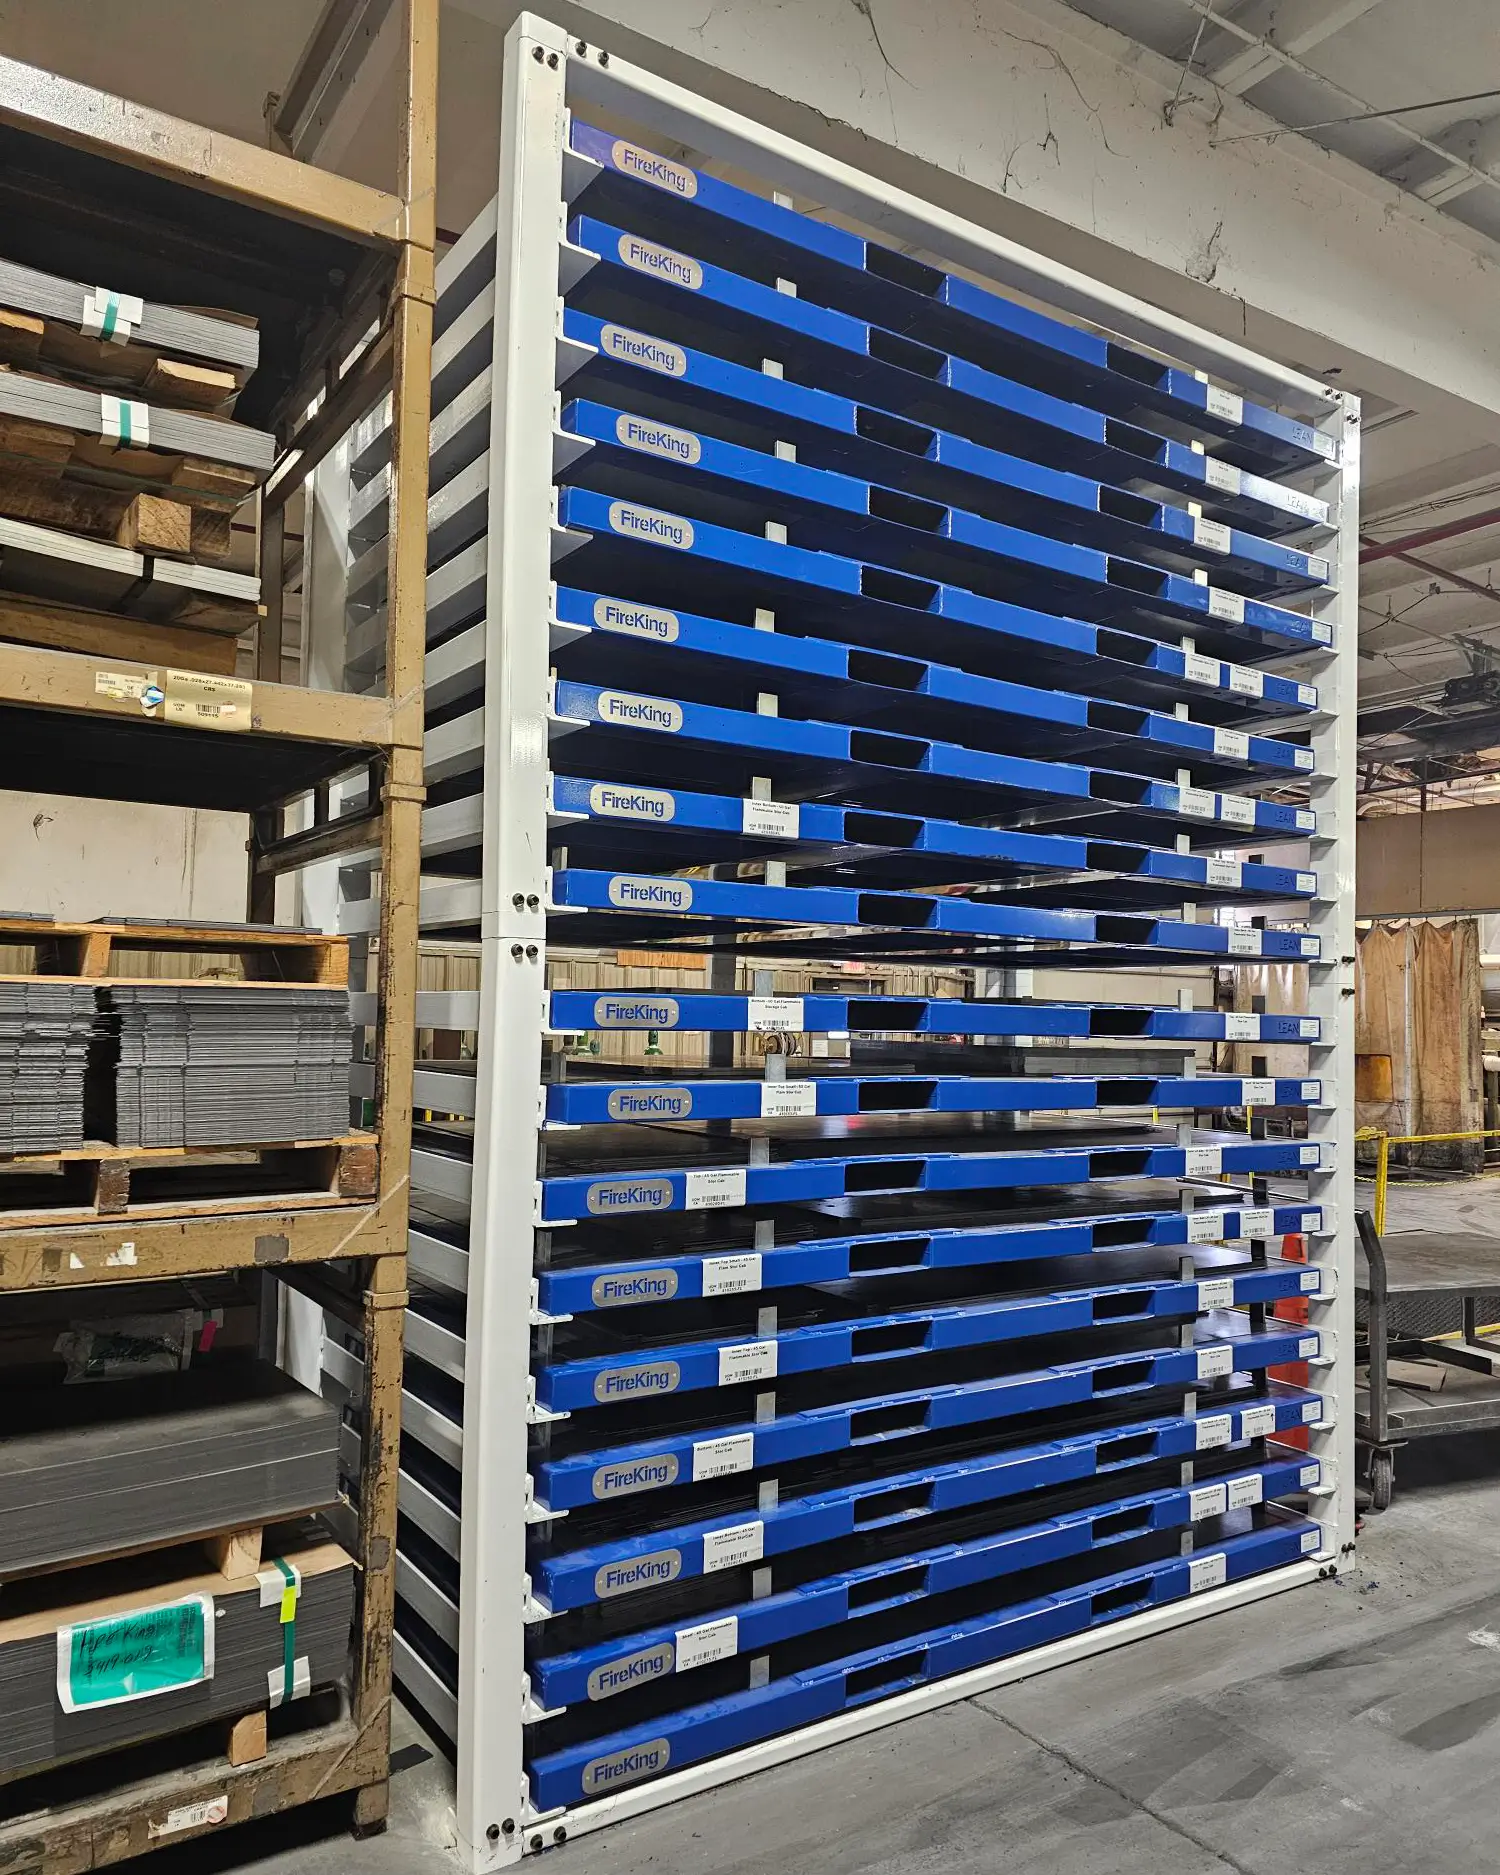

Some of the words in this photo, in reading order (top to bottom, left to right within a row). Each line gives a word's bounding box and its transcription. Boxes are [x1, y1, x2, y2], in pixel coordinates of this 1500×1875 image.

[624, 148, 687, 191] FireKing
[630, 244, 692, 283] FireKing
[613, 333, 675, 371] FireKing
[628, 422, 690, 459] FireKing
[621, 510, 683, 544] FireKing
[606, 606, 668, 637] FireKing
[609, 700, 672, 728] FireKing
[602, 790, 664, 818] FireKing
[620, 883, 683, 907] FireKing
[605, 1004, 669, 1024] FireKing
[619, 1095, 682, 1115] FireKing
[598, 1187, 663, 1207] FireKing
[603, 1278, 667, 1299] FireKing
[605, 1371, 669, 1394] FireKing
[604, 1464, 668, 1489] FireKing
[605, 1560, 670, 1589] FireKing
[599, 1656, 664, 1691] FireKing
[594, 1751, 660, 1785] FireKing
